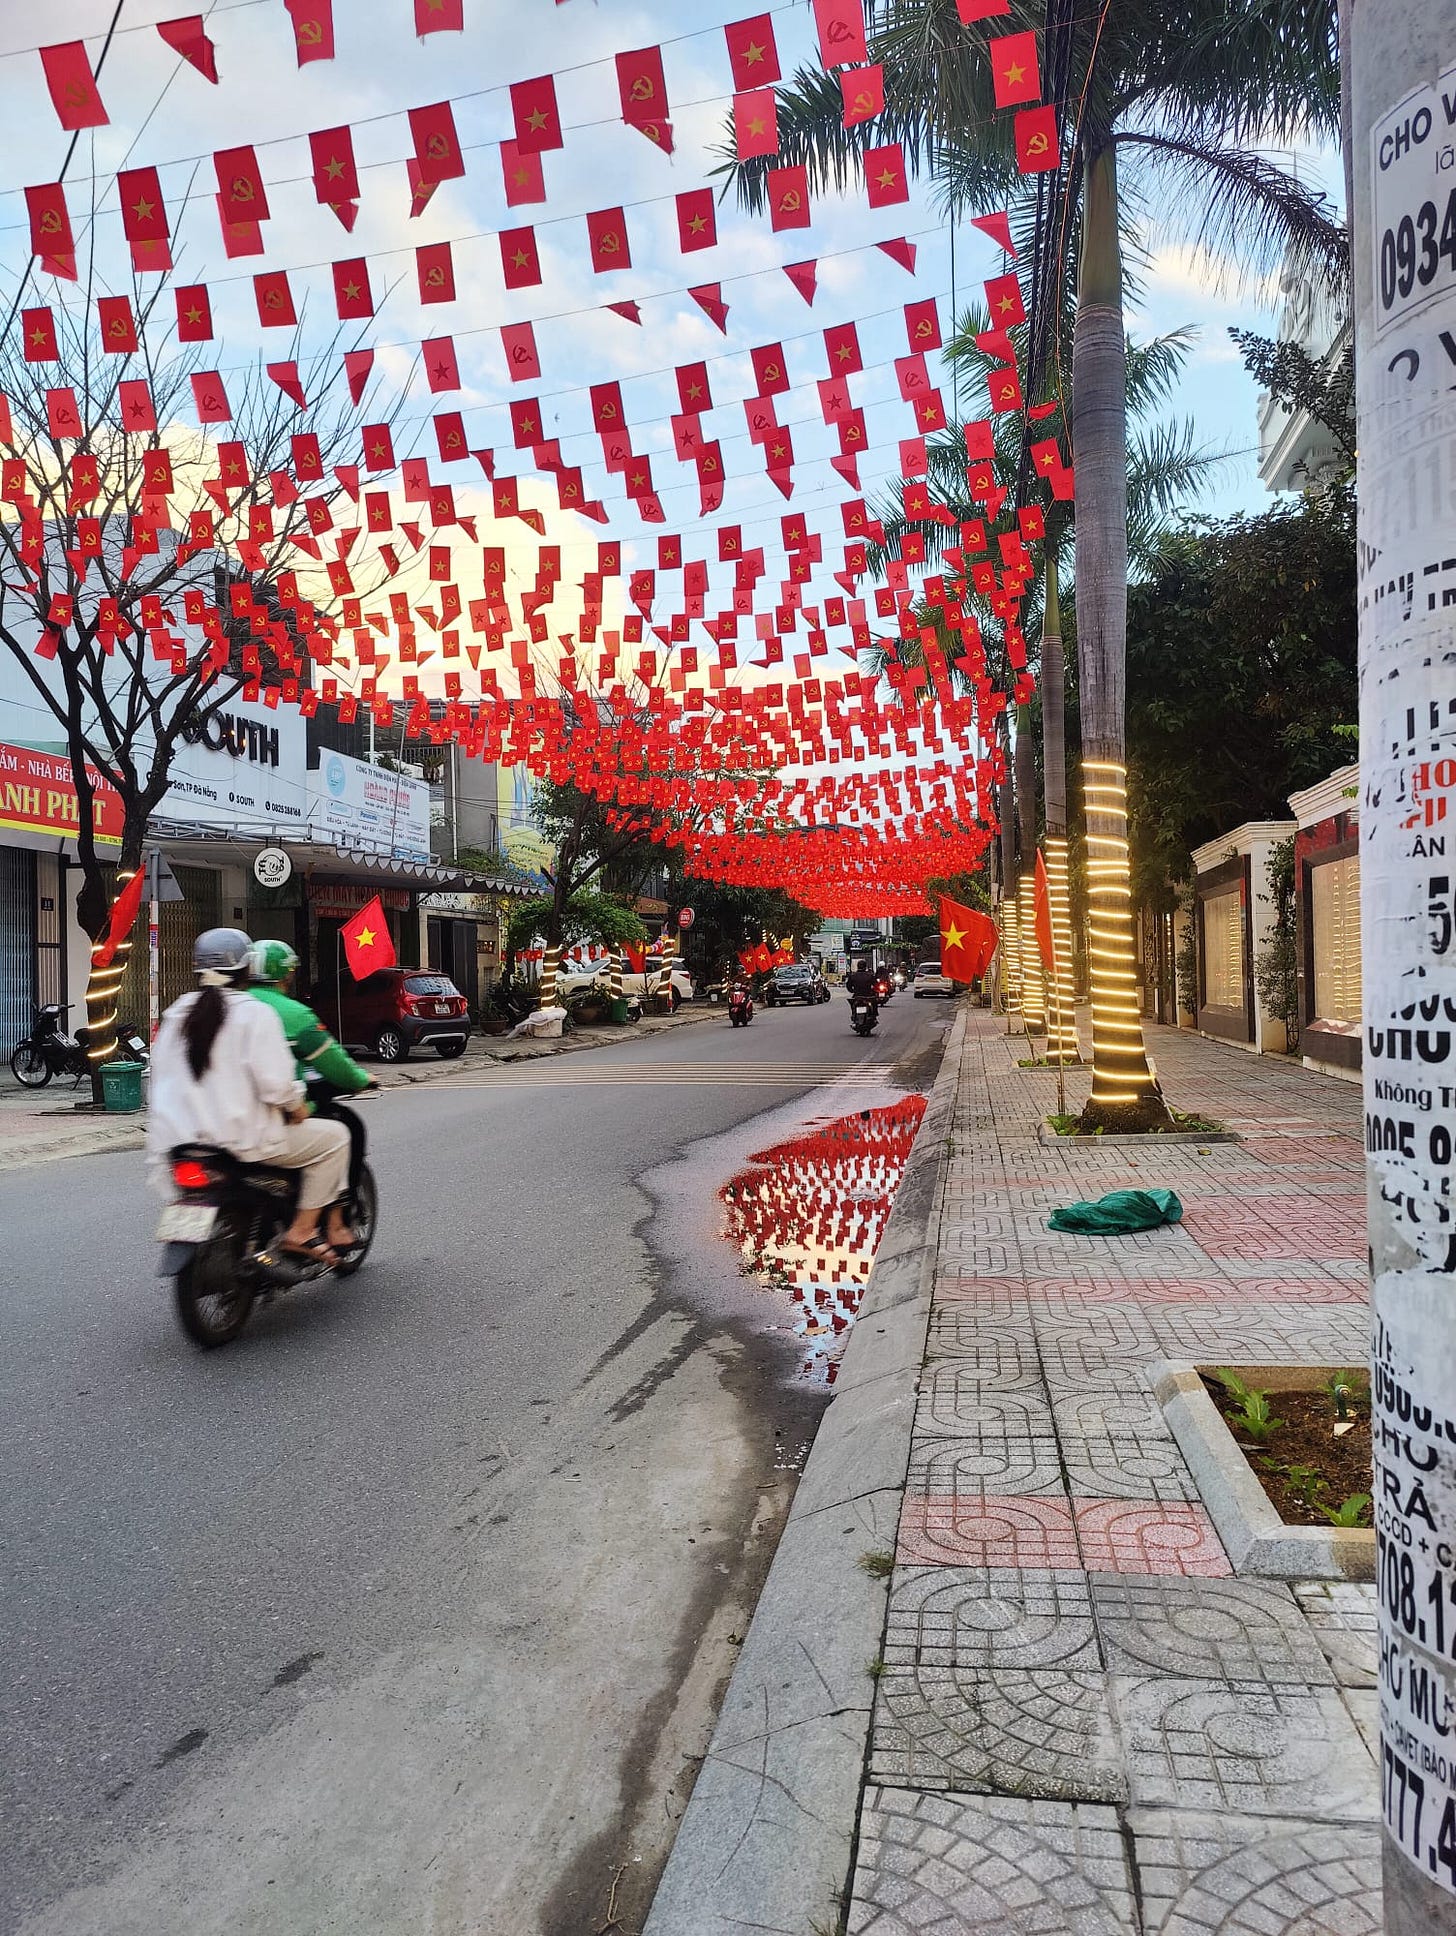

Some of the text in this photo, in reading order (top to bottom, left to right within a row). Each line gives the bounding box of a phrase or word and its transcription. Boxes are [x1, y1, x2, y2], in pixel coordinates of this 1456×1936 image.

[1379, 107, 1432, 171] CHO
[28, 759, 52, 779] NHÀ
[46, 789, 107, 827] PHT
[236, 795, 255, 807] SOUTH
[1375, 1079, 1432, 1111] Không
[1378, 1502, 1412, 1547] CCCD
